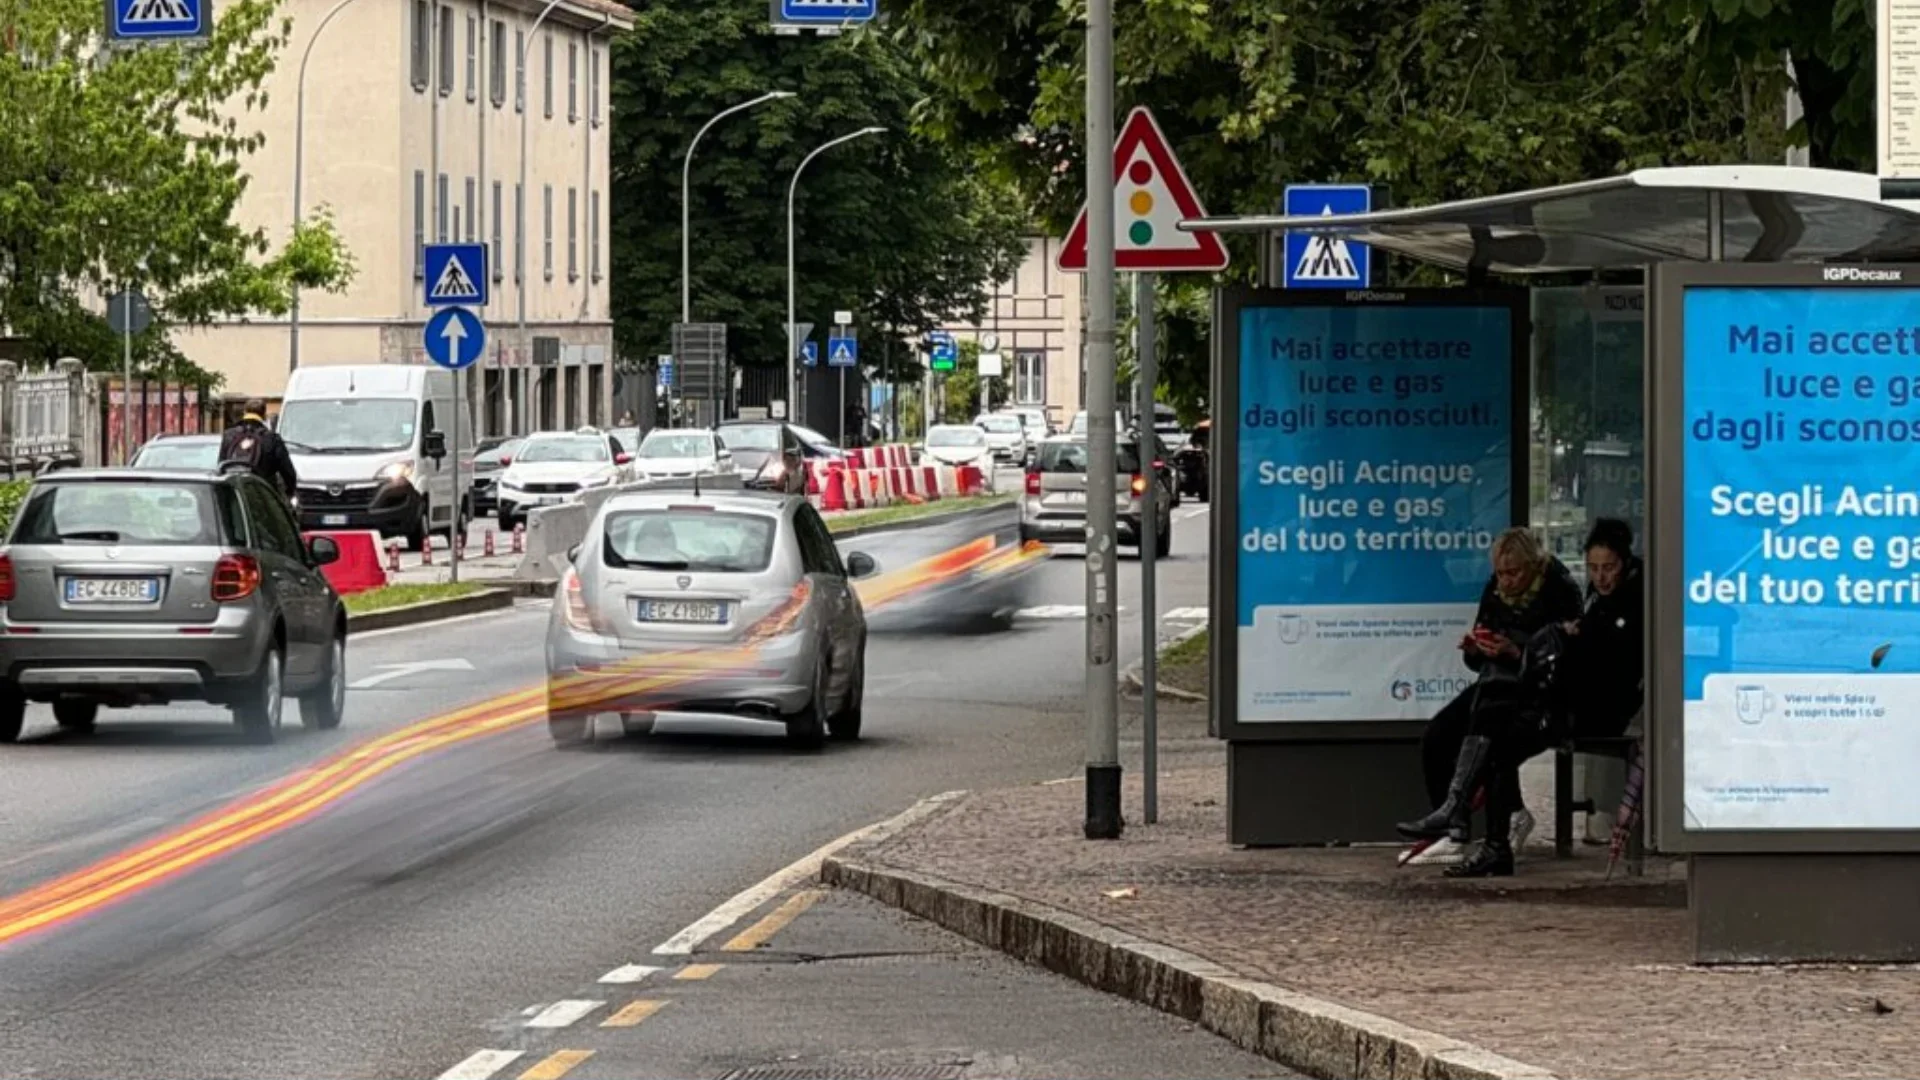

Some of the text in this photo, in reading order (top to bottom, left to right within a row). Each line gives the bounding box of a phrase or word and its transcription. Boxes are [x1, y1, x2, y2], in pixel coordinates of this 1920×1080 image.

[1823, 268, 1901, 281] IGPDecaux
[1270, 336, 1472, 360] Mai accettare
[1728, 324, 1794, 354] Mai
[1299, 370, 1445, 398] luce e gas
[1764, 367, 1841, 399] luce
[1853, 374, 1874, 399] e
[1244, 404, 1499, 433] dagli sconosciuti.
[1692, 411, 1785, 450] dagli
[1258, 460, 1344, 490] Scegli
[1299, 494, 1445, 522] luce e gas
[1711, 484, 1823, 525] Scegli
[1242, 527, 1288, 552] del
[1296, 530, 1346, 551] tuo
[1763, 528, 1841, 560] luce
[1853, 535, 1875, 560] e
[1689, 570, 1748, 604] del
[1760, 573, 1825, 604] tuo
